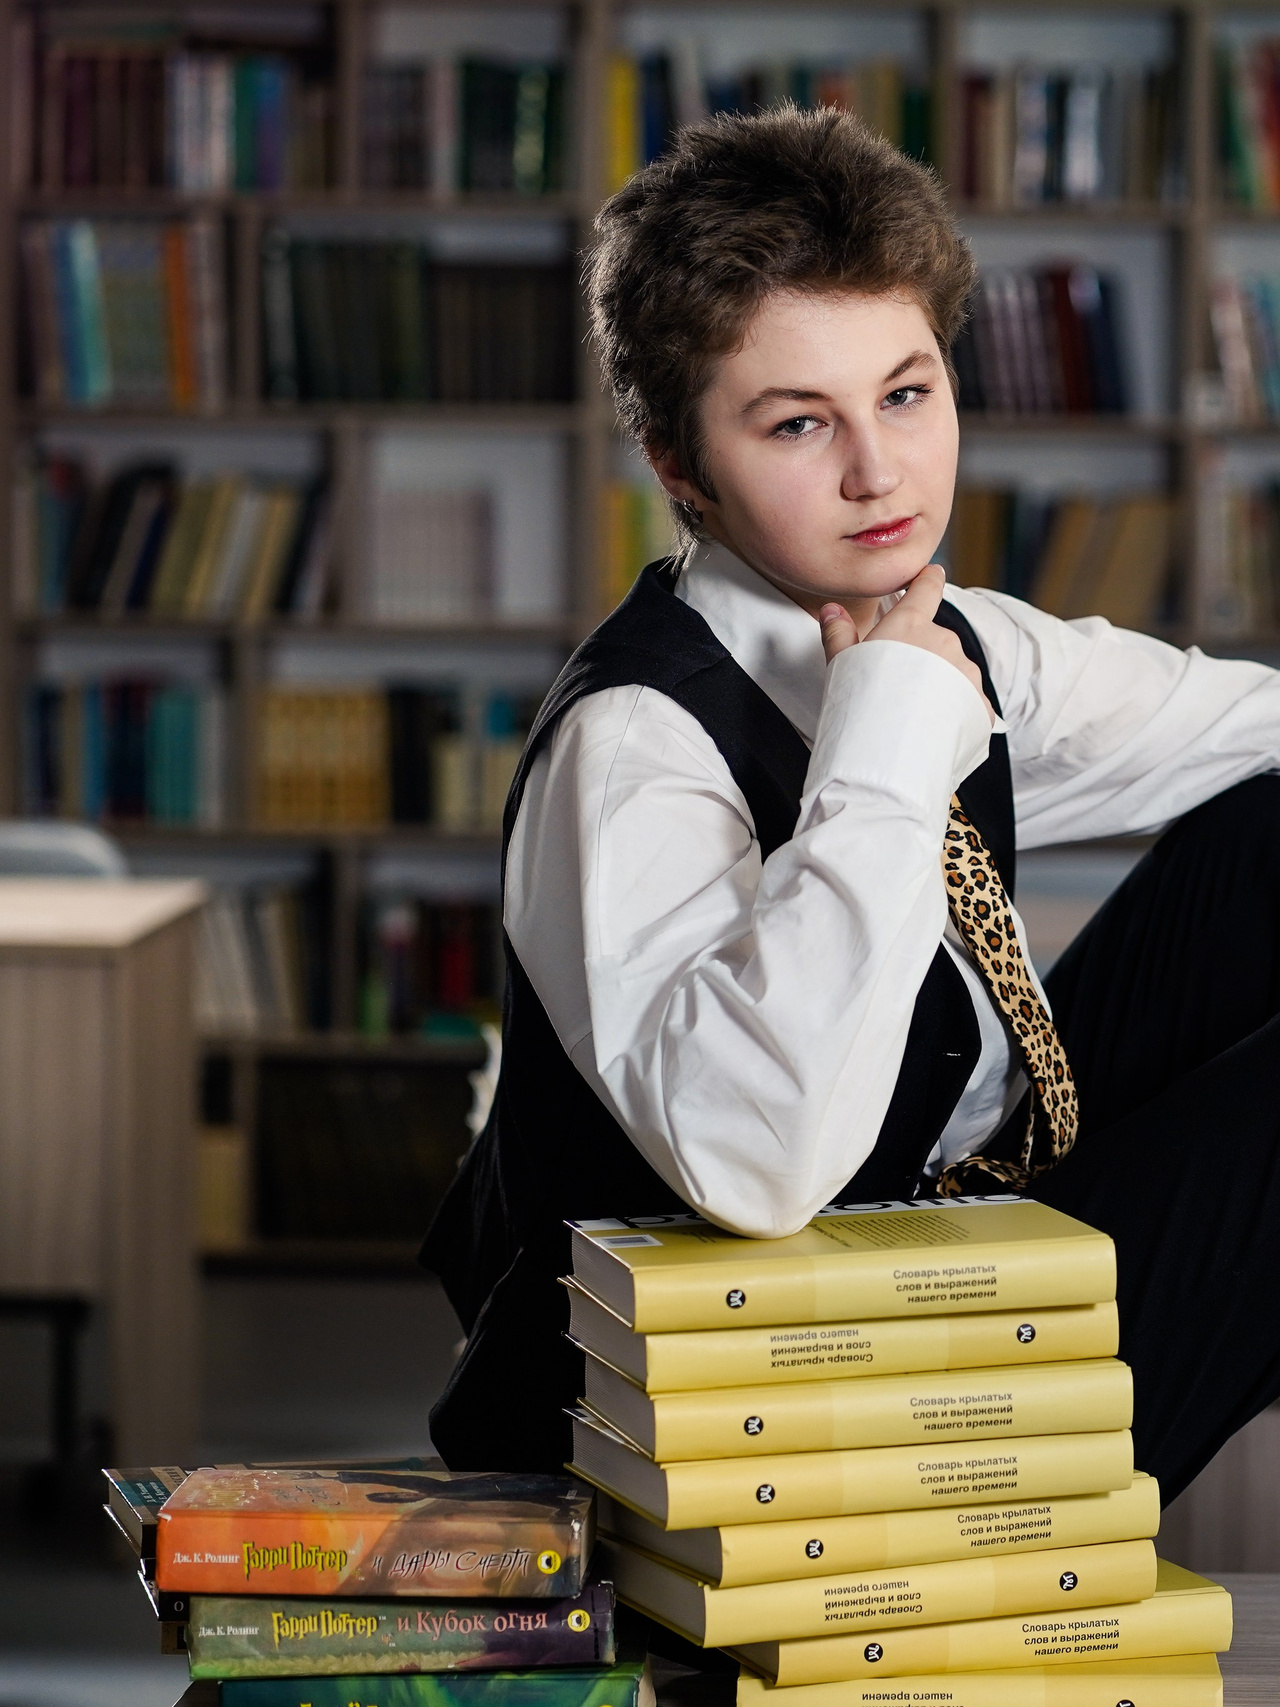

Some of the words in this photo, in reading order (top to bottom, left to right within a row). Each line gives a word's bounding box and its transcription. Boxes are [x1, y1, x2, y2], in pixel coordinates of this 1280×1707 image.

[893, 1269, 940, 1280] Словарь
[942, 1265, 997, 1278] крылатых
[896, 1283, 922, 1292] слов
[934, 1277, 997, 1290] выражений
[907, 1294, 947, 1303] нашего
[950, 1290, 997, 1301] времени
[770, 1331, 817, 1343] времени
[820, 1329, 859, 1339] нашего
[771, 1343, 834, 1358] выражений
[837, 1343, 843, 1351] и
[846, 1341, 871, 1350] слов
[771, 1356, 825, 1368] крылатых
[827, 1353, 874, 1363] Словарь
[910, 1397, 957, 1407] Словарь
[959, 1393, 1013, 1405] крылатых
[913, 1411, 939, 1420] слов
[941, 1410, 948, 1418] и
[950, 1405, 1013, 1418] выражений
[924, 1421, 963, 1431] нашего
[966, 1418, 1013, 1430] времени
[918, 1462, 963, 1472] Словарь
[965, 1456, 1018, 1469] крылатых
[920, 1476, 946, 1485] слов
[957, 1468, 1018, 1482] выражений
[931, 1485, 970, 1496] нашего
[972, 1481, 1018, 1493] времени
[957, 1514, 1000, 1524] Словарь
[1002, 1506, 1052, 1520] крылатых
[960, 1528, 984, 1537] слов
[994, 1517, 1052, 1532] выражений
[970, 1536, 1007, 1547] нашего
[1008, 1531, 1052, 1544] времени
[173, 1552, 191, 1564] Дж.
[194, 1553, 203, 1563] К.
[205, 1553, 240, 1564] Ролинг
[242, 1541, 289, 1581] Гарри
[290, 1541, 348, 1572] Поттер
[824, 1583, 869, 1596] времени
[872, 1581, 909, 1591] нашего
[825, 1596, 886, 1611] выражений
[897, 1592, 921, 1601] слов
[825, 1608, 876, 1622] крылатых
[879, 1604, 923, 1615] Словарь
[217, 1626, 225, 1636] К.
[226, 1626, 259, 1636] Ролинг
[272, 1611, 318, 1650] Гарри
[320, 1609, 378, 1639] Поттер
[397, 1617, 410, 1631] и
[416, 1609, 486, 1641] Кубок
[493, 1612, 548, 1632] огня
[1022, 1623, 1066, 1633] Словарь
[1068, 1618, 1119, 1631] крылатых
[1024, 1637, 1049, 1646] слов
[1060, 1630, 1120, 1643] выражений
[1034, 1646, 1072, 1656] нашего
[1074, 1643, 1119, 1654] времени
[862, 1691, 910, 1701] времени
[912, 1692, 953, 1701] нашего
